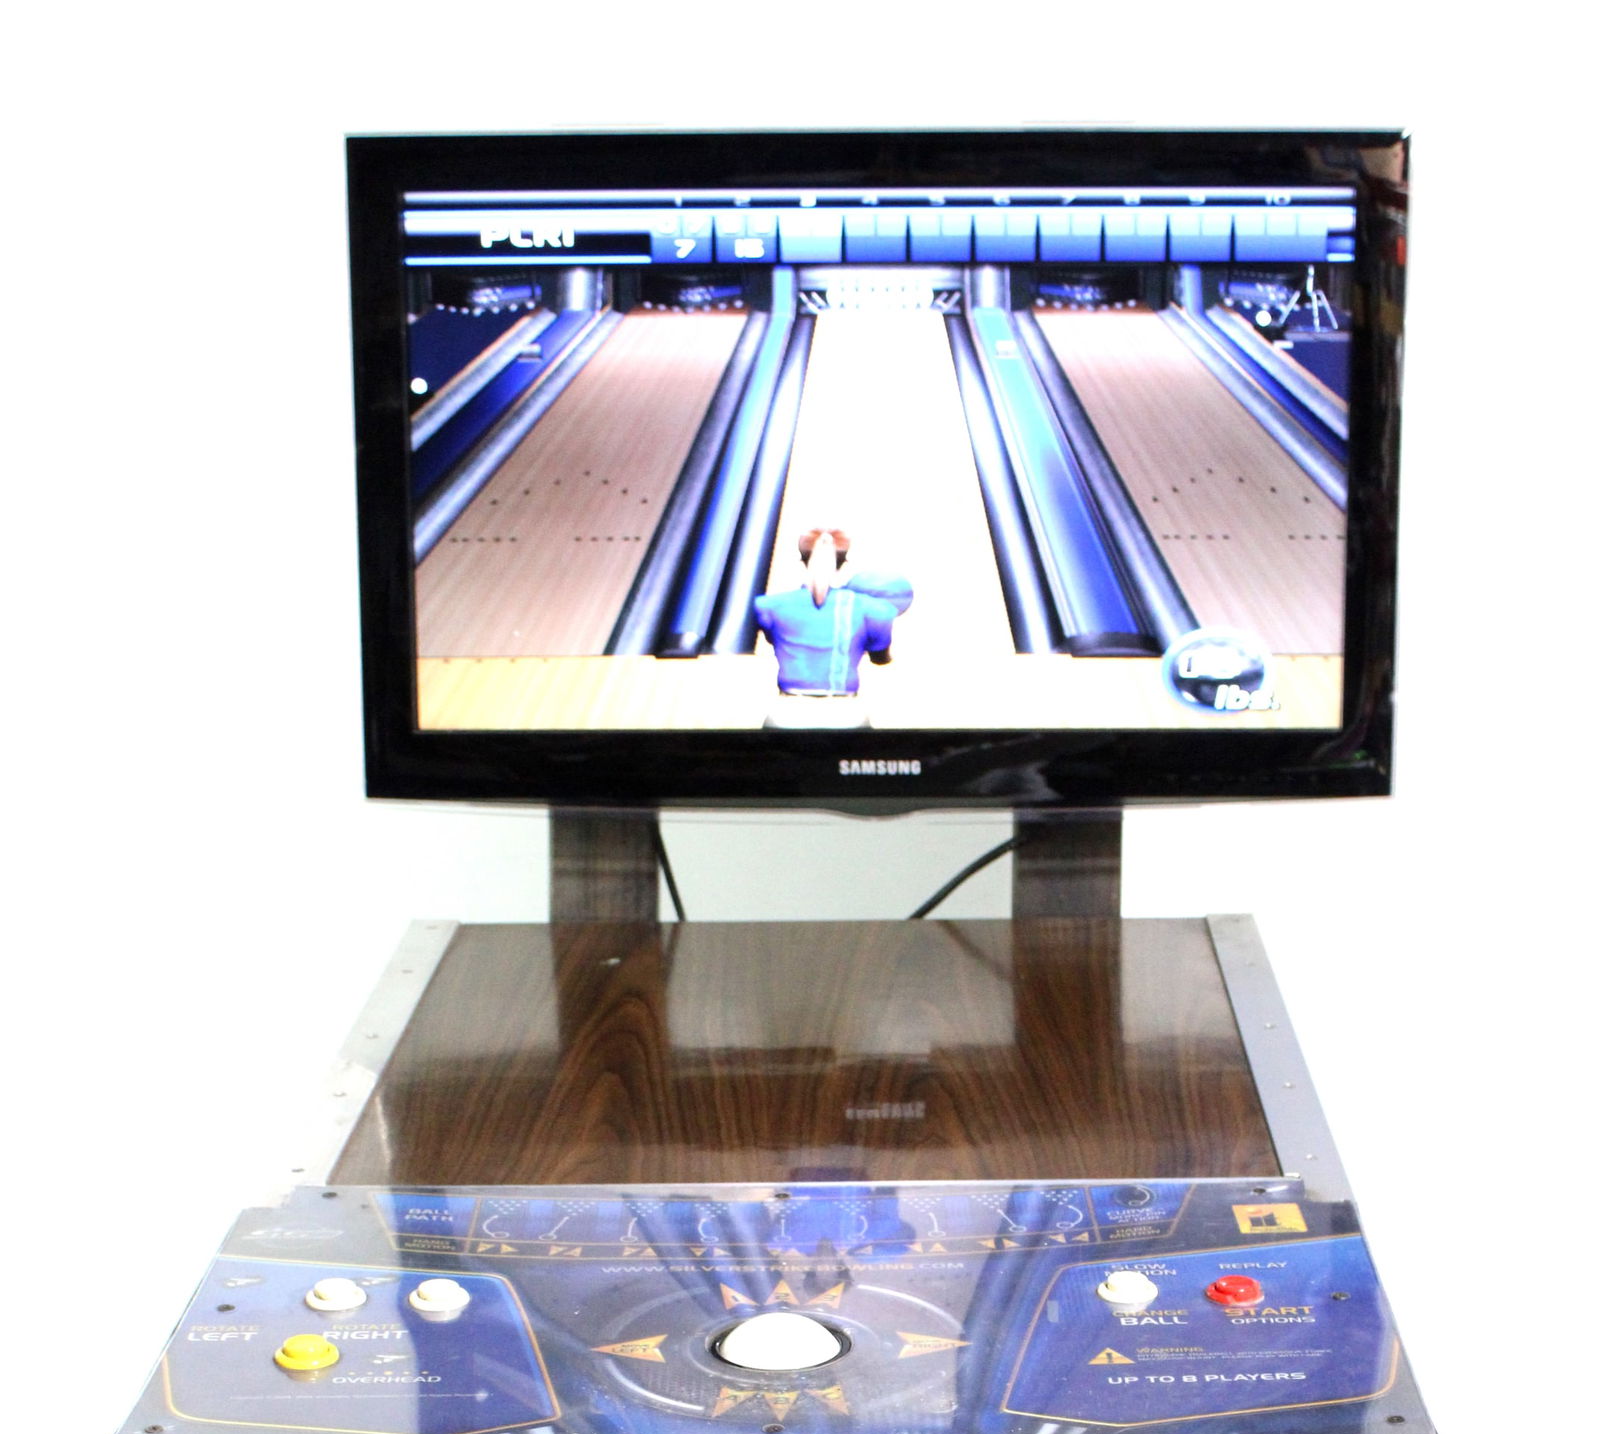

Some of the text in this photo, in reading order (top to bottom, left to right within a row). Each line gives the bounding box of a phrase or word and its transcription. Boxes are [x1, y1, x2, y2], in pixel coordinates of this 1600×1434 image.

[838, 760, 922, 776] SAMSUNG
[1111, 1263, 1167, 1271] SLOW
[1219, 1261, 1287, 1269] REPLAY
[1112, 1309, 1188, 1317] CHANGE
[1224, 1306, 1314, 1317] START
[1120, 1316, 1188, 1326] BALL
[1231, 1316, 1316, 1325] OPTIONS
[187, 1332, 258, 1342] LEFT
[323, 1330, 408, 1341] RIGHT
[331, 1376, 442, 1384] OVERHEAD
[1107, 1372, 1306, 1385] UP TO 8 PLAYERS
